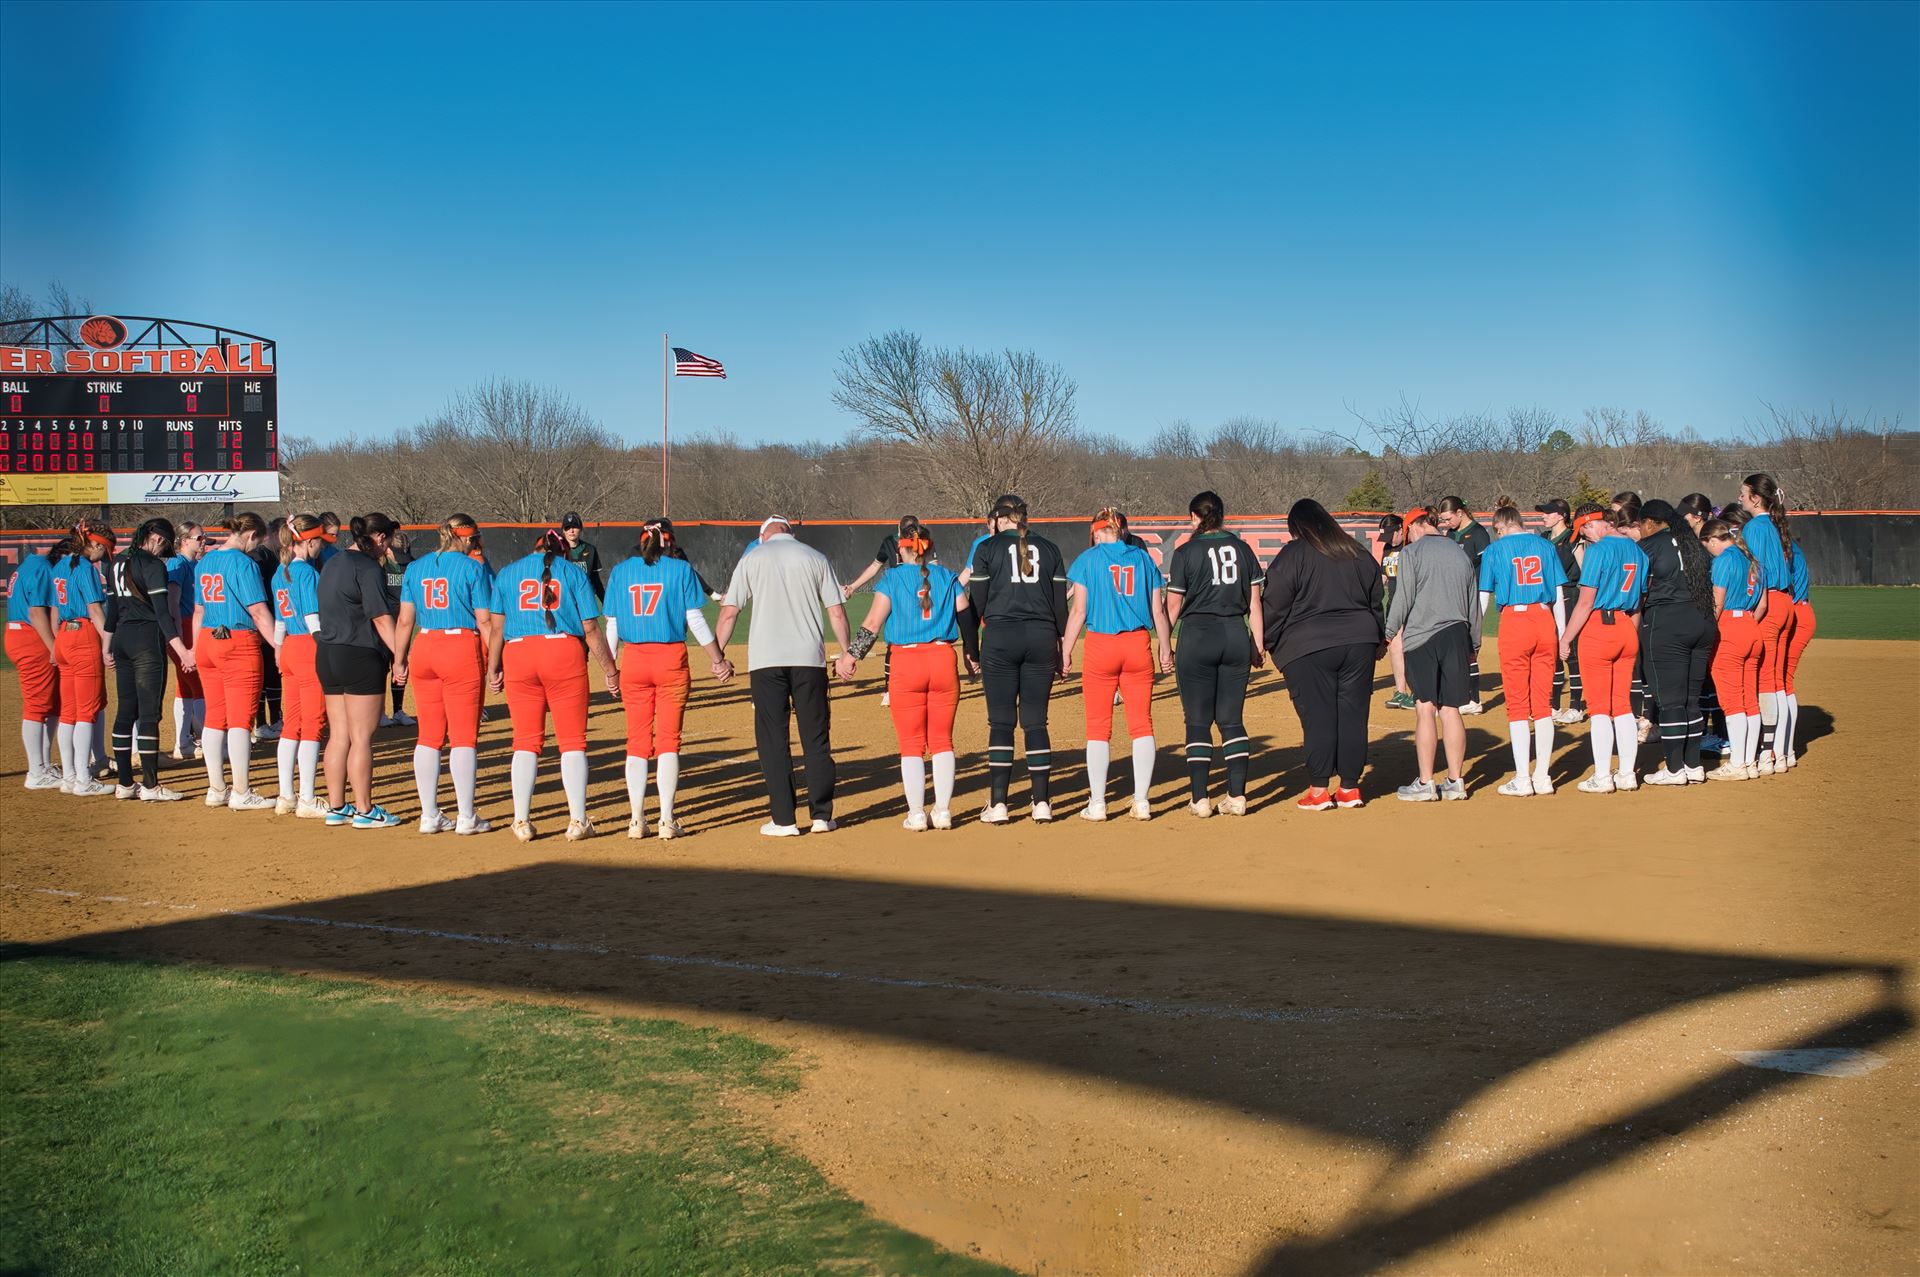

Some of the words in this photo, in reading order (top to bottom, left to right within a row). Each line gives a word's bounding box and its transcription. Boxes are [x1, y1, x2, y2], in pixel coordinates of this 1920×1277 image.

[0, 346, 56, 373] ER
[65, 341, 273, 373] SOFTBALL
[2, 381, 30, 393] BALL
[87, 381, 122, 393] STRIKE
[180, 381, 203, 393] OUT
[244, 381, 261, 393] H/E
[11, 395, 22, 413] 0
[99, 395, 110, 413] 0
[186, 394, 197, 412] 0
[1, 420, 8, 430] 2
[18, 420, 24, 430] 3
[35, 420, 41, 430] 4
[52, 420, 58, 430] 5
[69, 420, 75, 430] 6
[85, 420, 91, 430] 7
[102, 420, 108, 430] 8
[119, 420, 126, 430] 9
[133, 420, 144, 430] 10
[166, 420, 194, 431] RUNS
[218, 420, 242, 431] HITS
[267, 420, 274, 431] E
[49, 432, 60, 450] 0
[67, 432, 77, 450] 3
[83, 432, 93, 450] 0
[183, 432, 193, 450] 7
[16, 453, 27, 471] 2
[33, 453, 43, 471] 0
[67, 453, 77, 471] 0
[84, 453, 94, 471] 3
[183, 452, 193, 470] 5
[232, 452, 243, 470] 6
[152, 474, 236, 492] TFCU
[1208, 545, 1238, 585] 18
[1512, 555, 1543, 586] 12
[1109, 564, 1135, 596] 11
[1621, 563, 1637, 592] 7
[200, 573, 225, 602] 22
[421, 577, 449, 609] 13
[629, 583, 663, 616] 17
